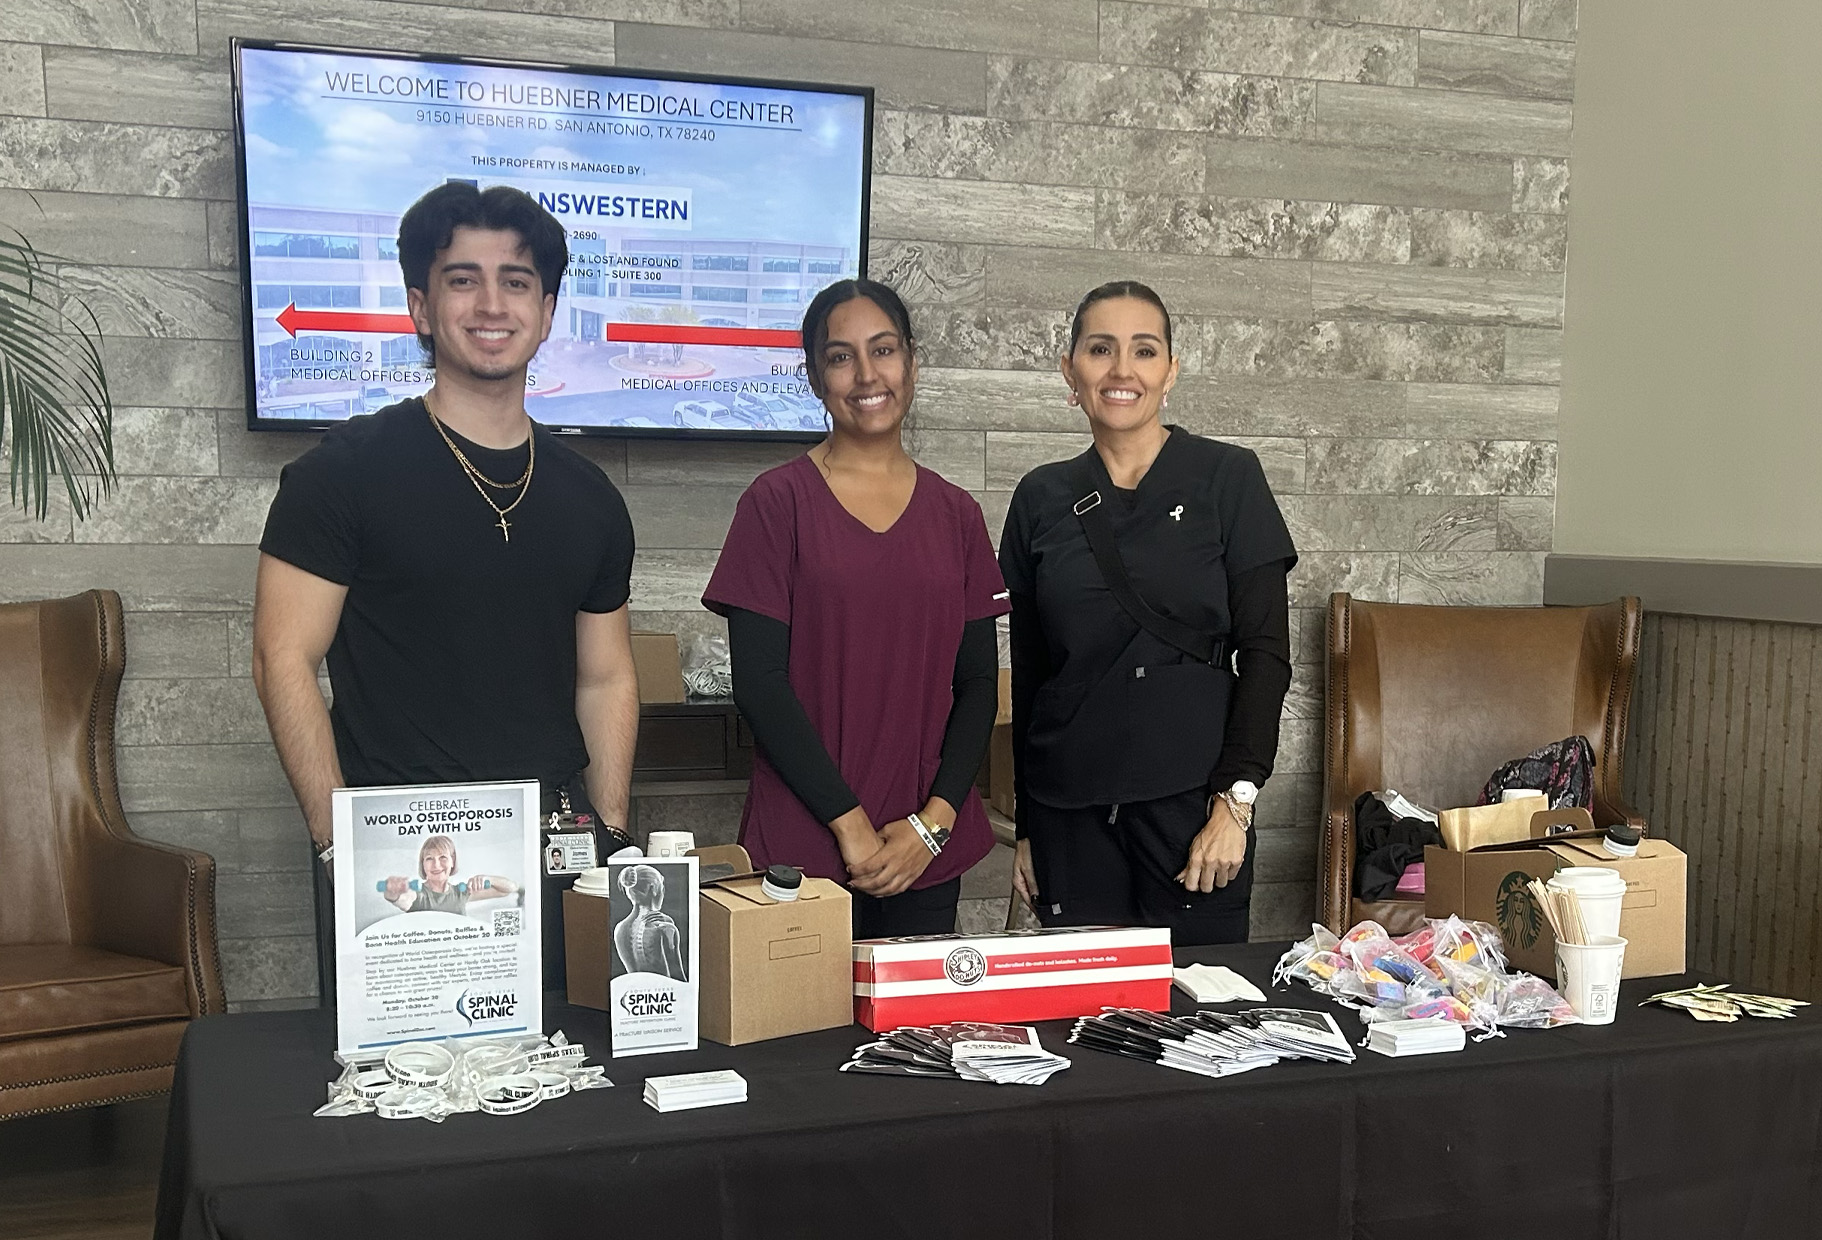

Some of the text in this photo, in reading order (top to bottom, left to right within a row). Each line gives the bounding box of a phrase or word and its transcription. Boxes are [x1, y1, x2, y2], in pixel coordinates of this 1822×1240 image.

[325, 71, 794, 124] WELCOME TO HUEBNER MEDICAL CENTER
[416, 109, 451, 124] 9150
[455, 112, 524, 129] HUEBNER
[555, 119, 583, 133] SAN
[586, 122, 654, 139] ANTONIO,
[658, 126, 673, 139] TX
[677, 127, 716, 142] 78240
[471, 156, 496, 167] THIS
[499, 158, 556, 171] PROPERTY
[558, 162, 568, 171] IS
[571, 162, 625, 175] MANAGED
[627, 166, 640, 176] BY
[538, 190, 688, 221] NSWESTERN
[578, 254, 586, 264] &
[588, 254, 614, 265] LOST
[616, 256, 639, 266] AND
[642, 257, 679, 268] FOUND
[597, 269, 601, 279] 1
[612, 269, 642, 280] SUITE
[644, 271, 662, 281] 300
[289, 348, 374, 364] BUILDING 2
[290, 368, 357, 382] MEDICAL
[360, 370, 421, 384] OFFICES
[620, 377, 681, 391] MEDICAL
[683, 380, 738, 393] OFFICES
[741, 382, 769, 394] AND
[408, 798, 470, 812] CELEBRATE
[364, 807, 514, 826] WORLD OSTEOPOROSIS
[398, 821, 482, 836] DAY WITH US
[408, 937, 441, 945] Education
[453, 933, 479, 941] October
[950, 953, 978, 966] SHIPLEY
[468, 993, 518, 1008] SPINAL
[628, 991, 677, 1005] SPINAL
[471, 1005, 514, 1020] CLINIC
[631, 1003, 673, 1016] CLINIC
